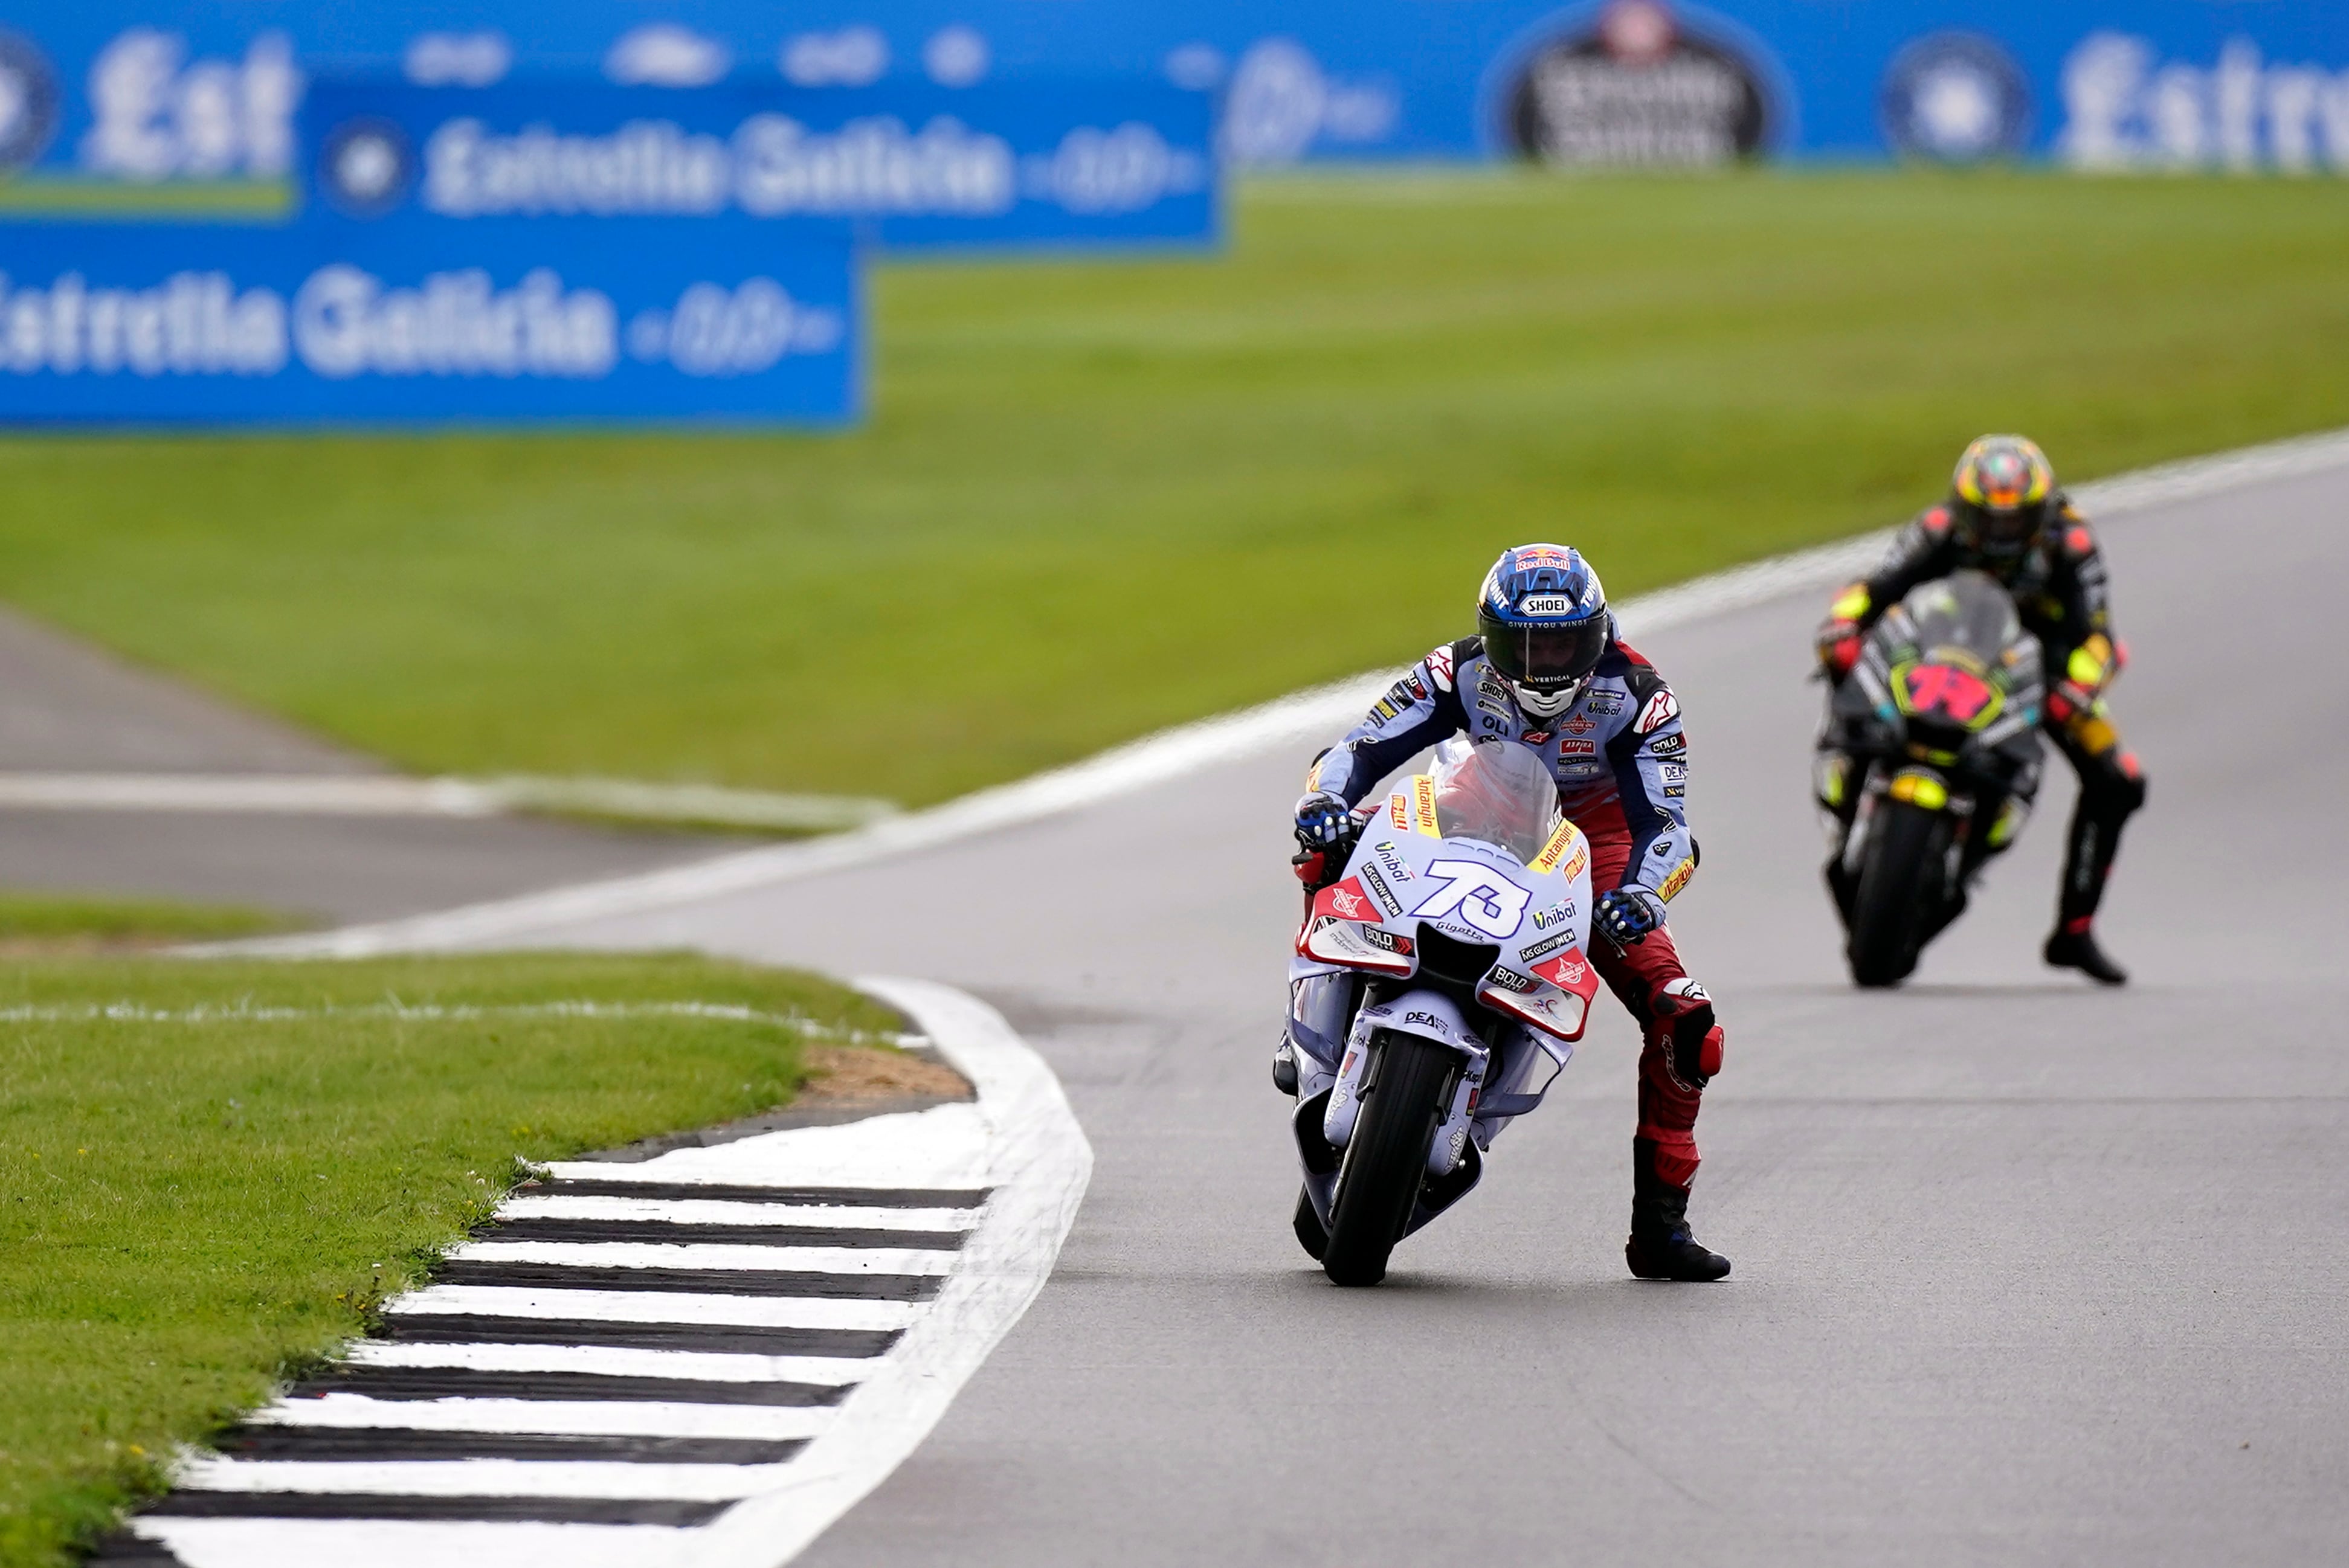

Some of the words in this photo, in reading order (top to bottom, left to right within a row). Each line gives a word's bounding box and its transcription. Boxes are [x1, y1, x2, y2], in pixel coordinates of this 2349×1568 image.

[295, 268, 616, 374] Galicia
[1516, 559, 1542, 571] Red
[1544, 557, 1570, 571] Bull
[1529, 600, 1564, 611] SHOEI
[1561, 620, 1588, 628] WINGS
[1480, 683, 1505, 701] SHOEI
[1587, 701, 1622, 716] Unibat
[1418, 779, 1435, 827] Antangin
[1539, 824, 1573, 870] Antangin
[1374, 841, 1411, 882] Unibat
[1406, 859, 1533, 940] 73
[1532, 902, 1577, 930] Unibat
[1364, 927, 1393, 946] BOLD
[1495, 966, 1527, 989] BOLD
[1405, 1012, 1435, 1027] DEA
